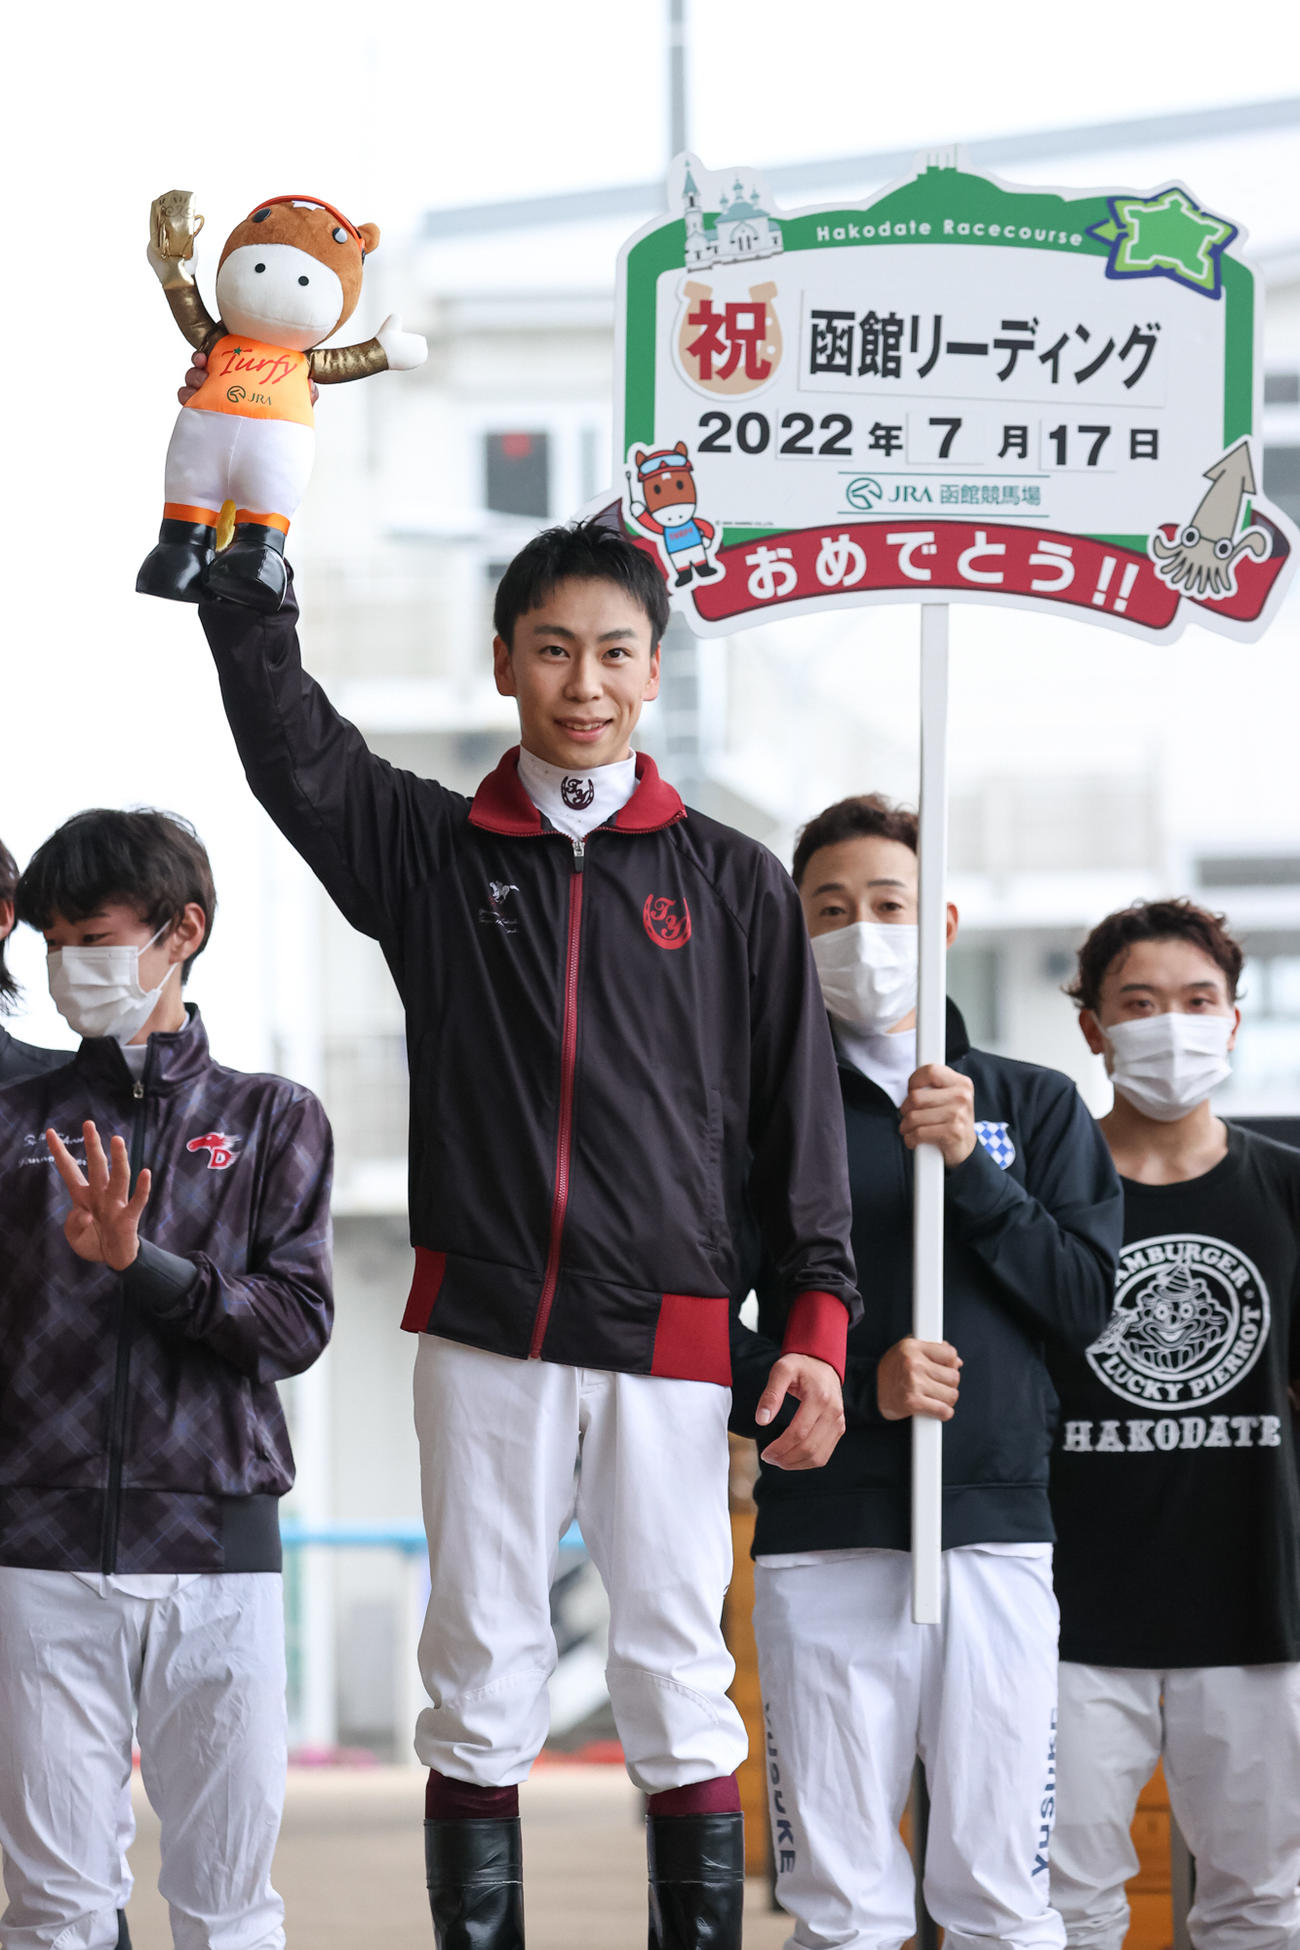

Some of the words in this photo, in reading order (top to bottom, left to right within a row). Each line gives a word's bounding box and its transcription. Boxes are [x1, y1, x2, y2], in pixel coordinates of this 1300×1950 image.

[816, 220, 932, 241] Hakodate
[943, 219, 1083, 246] Racecourse
[686, 299, 772, 381] 祝
[809, 309, 1162, 389] 函館リーディング
[219, 348, 298, 385] Turfy
[247, 392, 272, 406] JRA
[888, 485, 934, 503] JRA
[940, 484, 1041, 506] 函館競馬場
[1115, 1242, 1251, 1289] AMBURGER
[1101, 1353, 1184, 1401] LUCKY
[1188, 1304, 1262, 1399] PIERROT
[1063, 1415, 1282, 1453] HAKODATE
